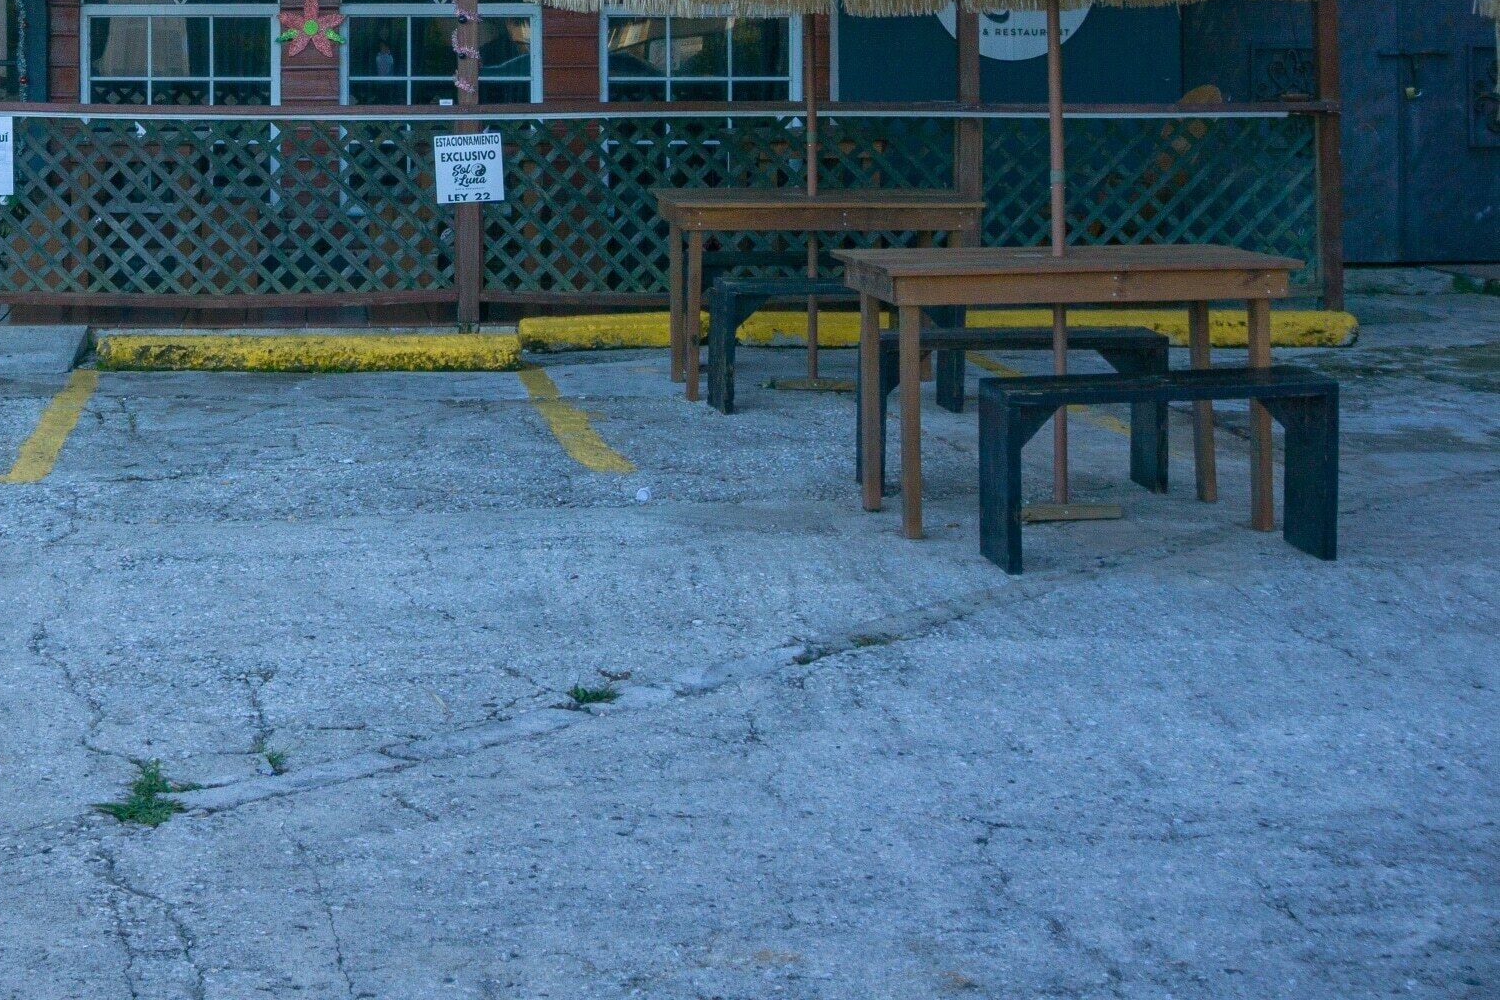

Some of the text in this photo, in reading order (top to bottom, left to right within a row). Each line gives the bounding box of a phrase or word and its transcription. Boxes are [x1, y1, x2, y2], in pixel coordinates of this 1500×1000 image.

[982, 28, 1070, 36] & RESTAURT
[436, 135, 500, 147] ESTACIONAMIENTO
[441, 150, 496, 162] EXCLUSIVO
[452, 164, 471, 177] Sol
[458, 174, 487, 187] Luna
[475, 192, 490, 200] 22
